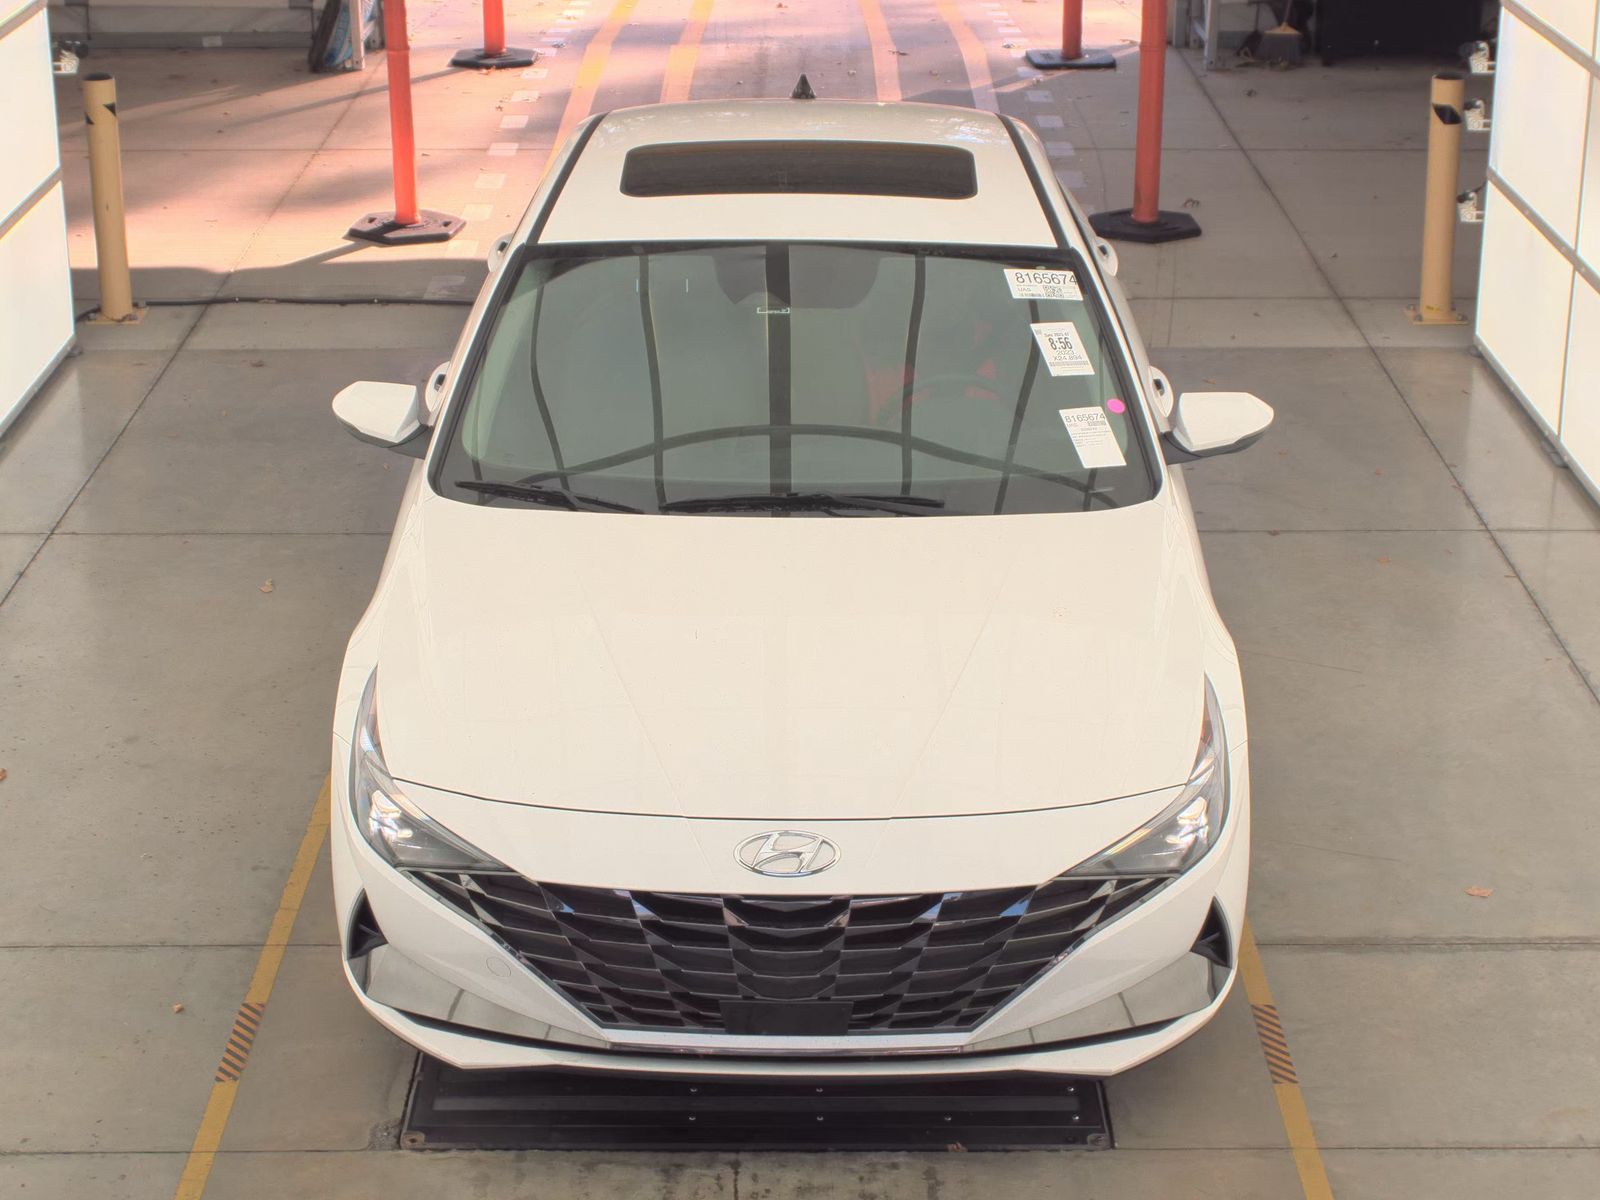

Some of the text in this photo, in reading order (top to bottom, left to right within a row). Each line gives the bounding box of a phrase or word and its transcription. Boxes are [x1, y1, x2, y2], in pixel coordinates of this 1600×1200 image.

[1015, 272, 1077, 285] 8165674
[1048, 337, 1073, 350] 8:56
[1064, 413, 1106, 423] 8165674
